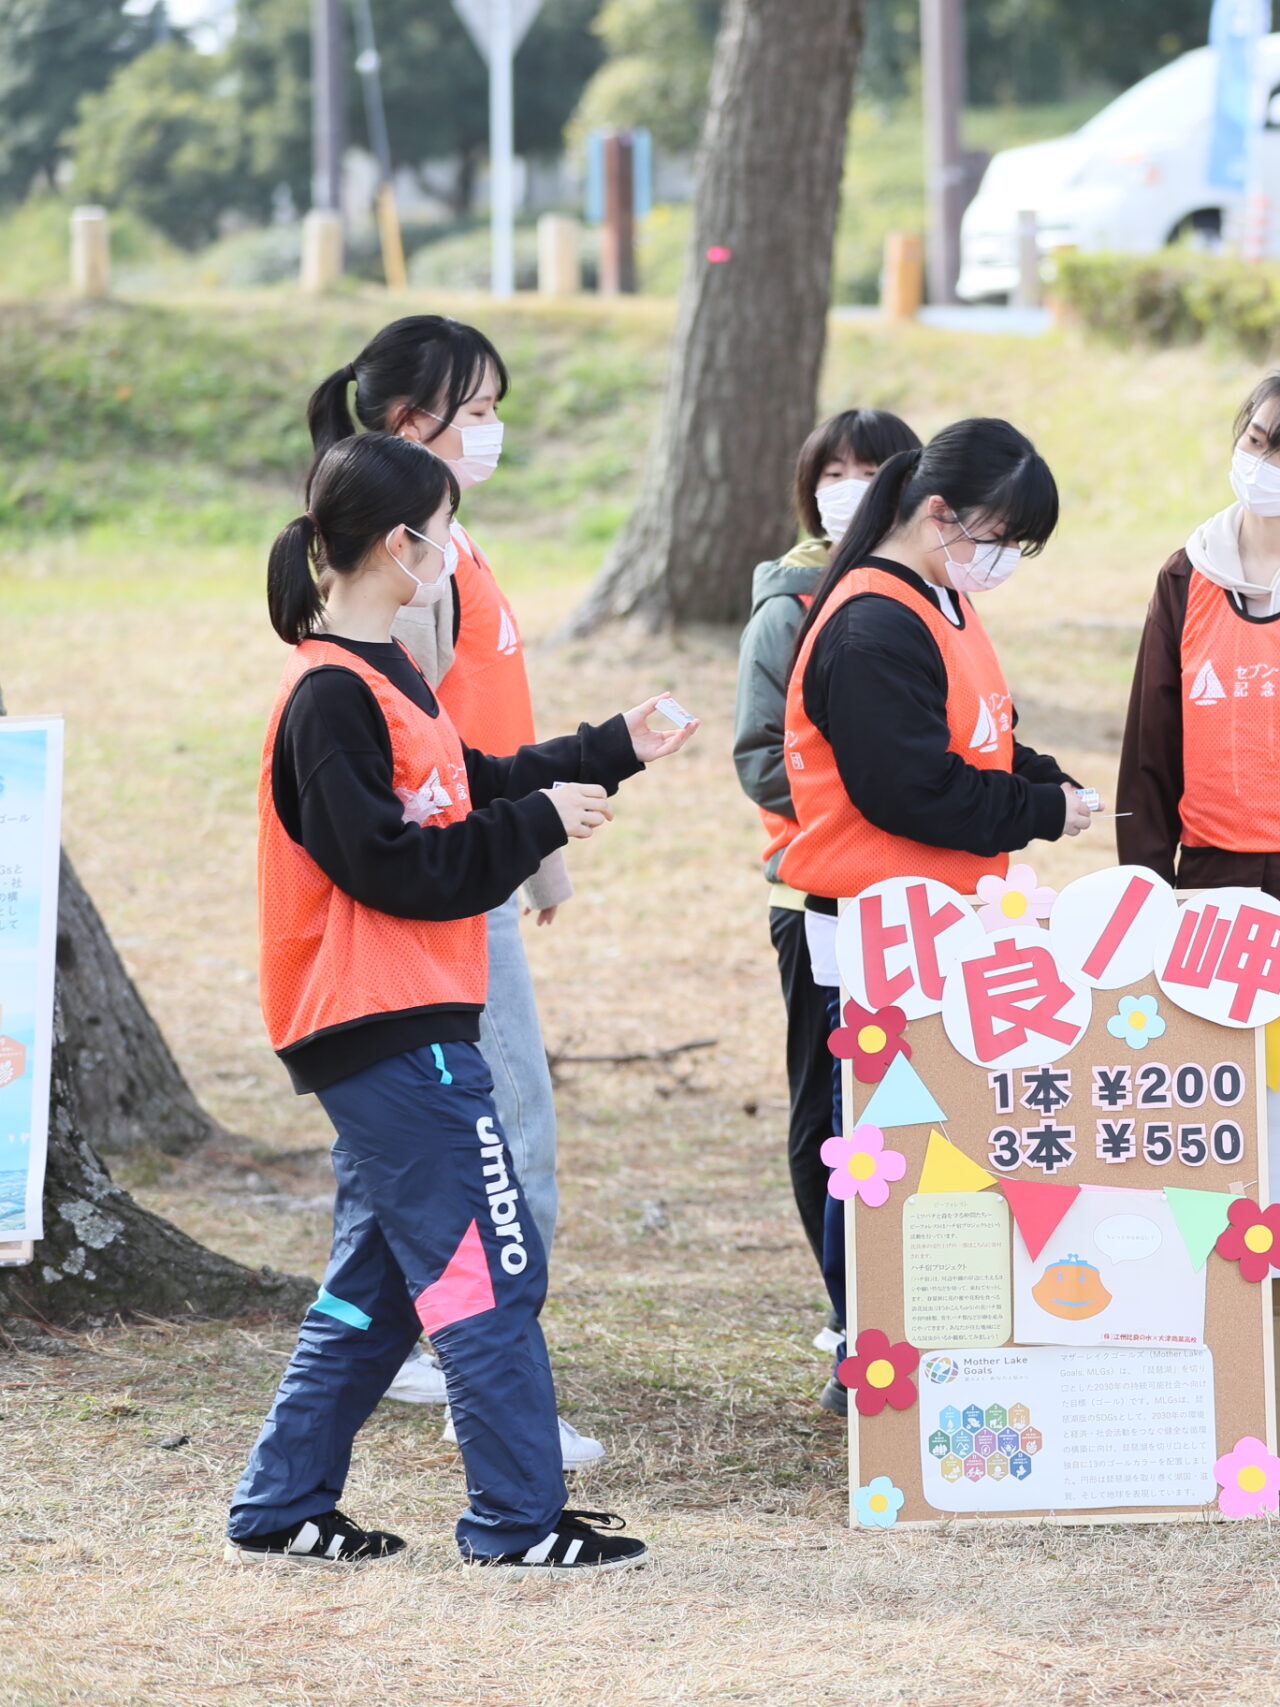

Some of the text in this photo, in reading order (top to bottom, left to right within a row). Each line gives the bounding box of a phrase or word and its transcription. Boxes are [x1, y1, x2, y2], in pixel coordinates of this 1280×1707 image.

[994, 1064, 1242, 1113] 1本 ¥200
[993, 1121, 1242, 1171] 3本 ¥550
[476, 1116, 528, 1275] umbro
[963, 1356, 1028, 1366] Mother Lake
[963, 1367, 993, 1375] Goals
